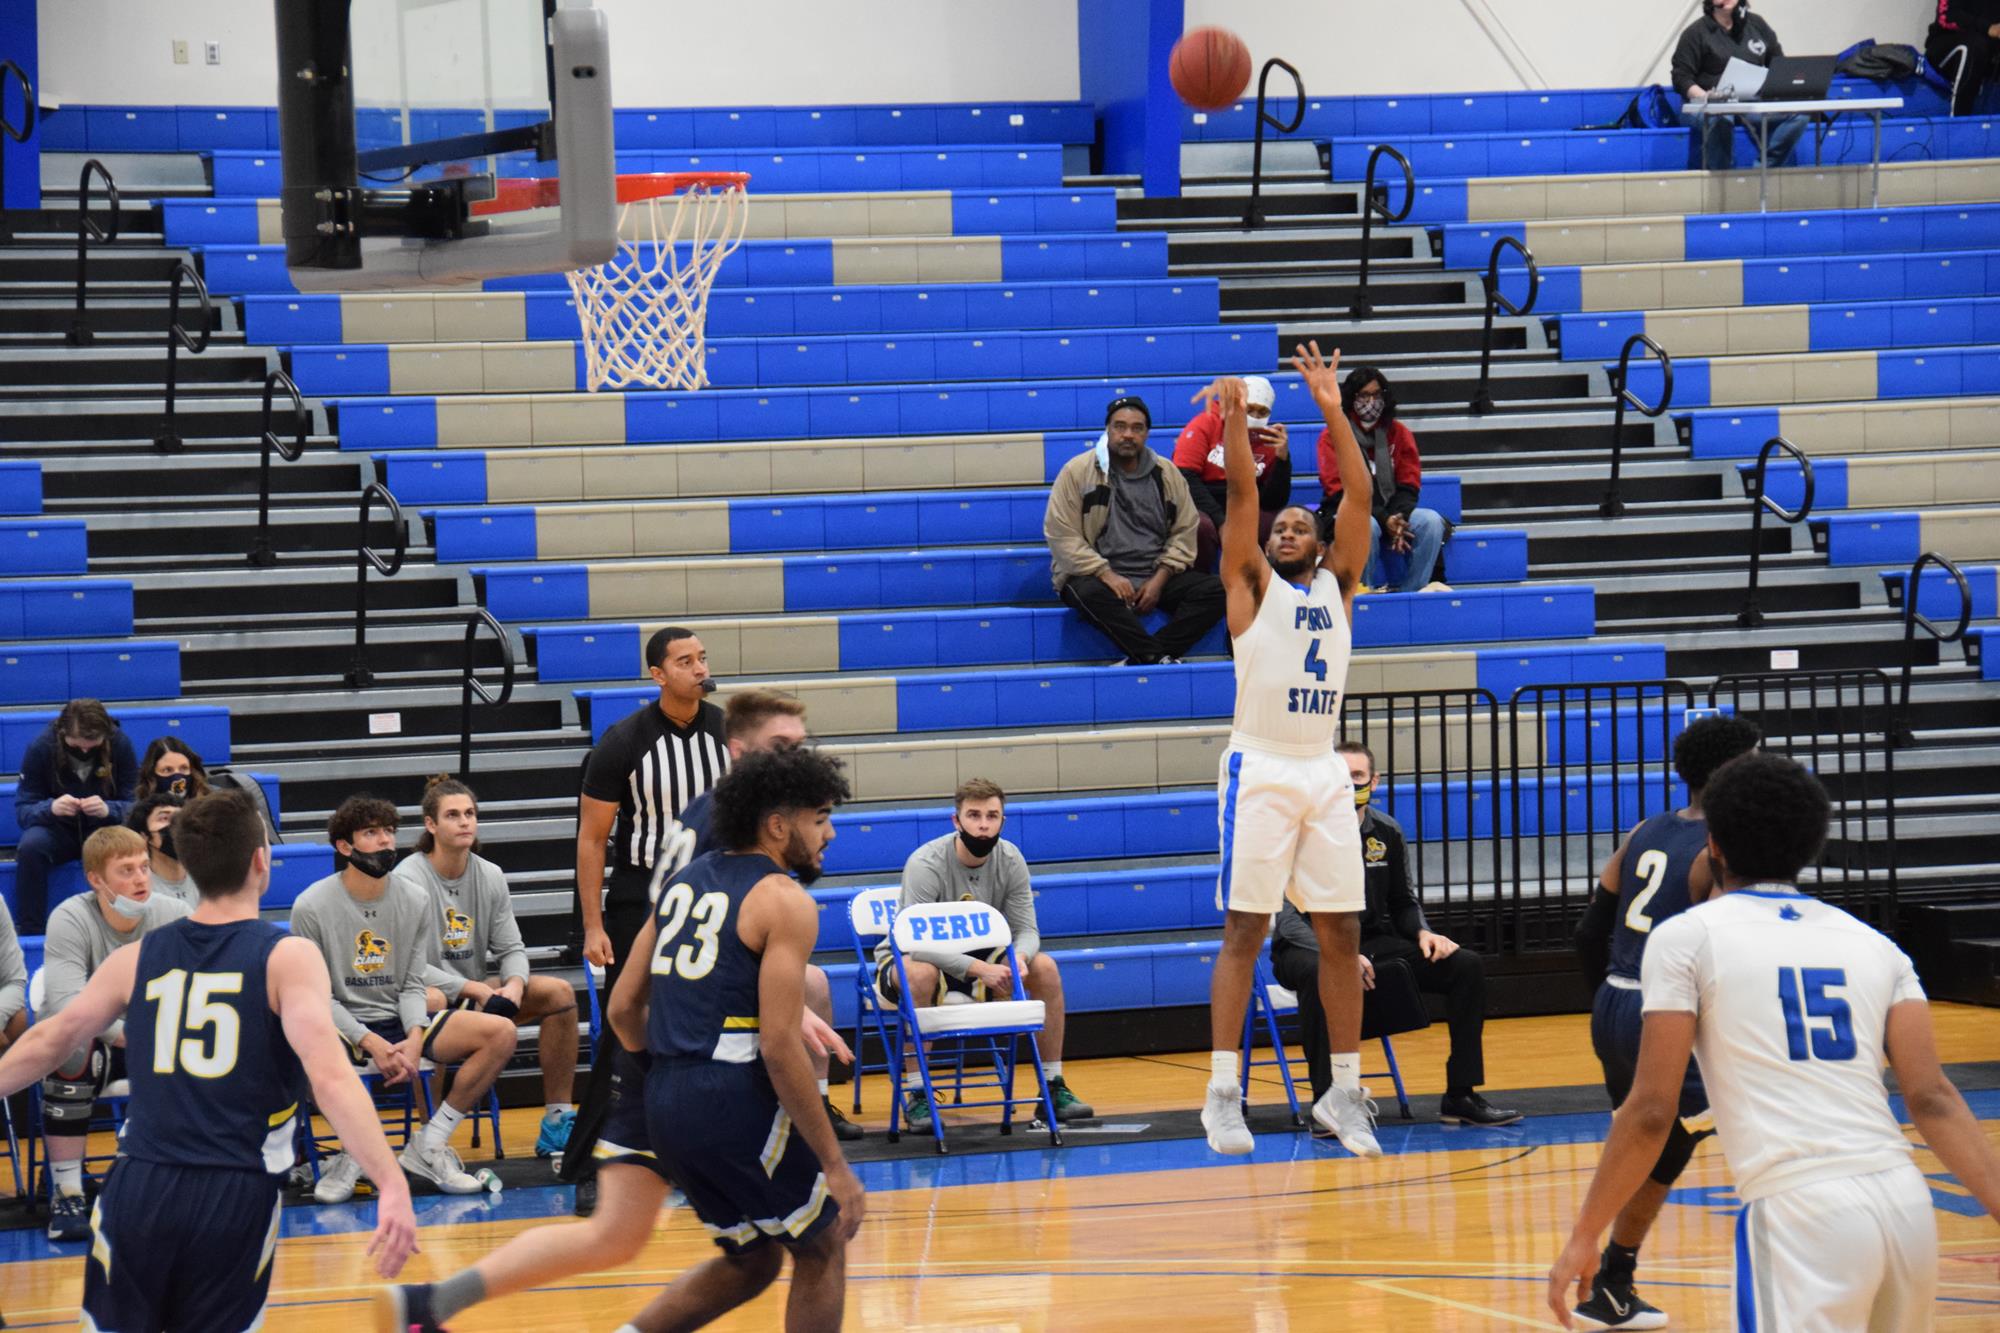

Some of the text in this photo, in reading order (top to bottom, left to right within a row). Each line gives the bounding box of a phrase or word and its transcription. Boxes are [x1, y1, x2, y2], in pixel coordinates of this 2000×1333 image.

[1304, 638, 1328, 682] 4
[1288, 687, 1338, 715] STATE
[869, 899, 898, 926] PE
[1625, 849, 1668, 933] 2
[650, 882, 729, 981] 23
[908, 911, 991, 941] PERU
[145, 967, 244, 1079] 15
[1777, 966, 1858, 1062] 15
